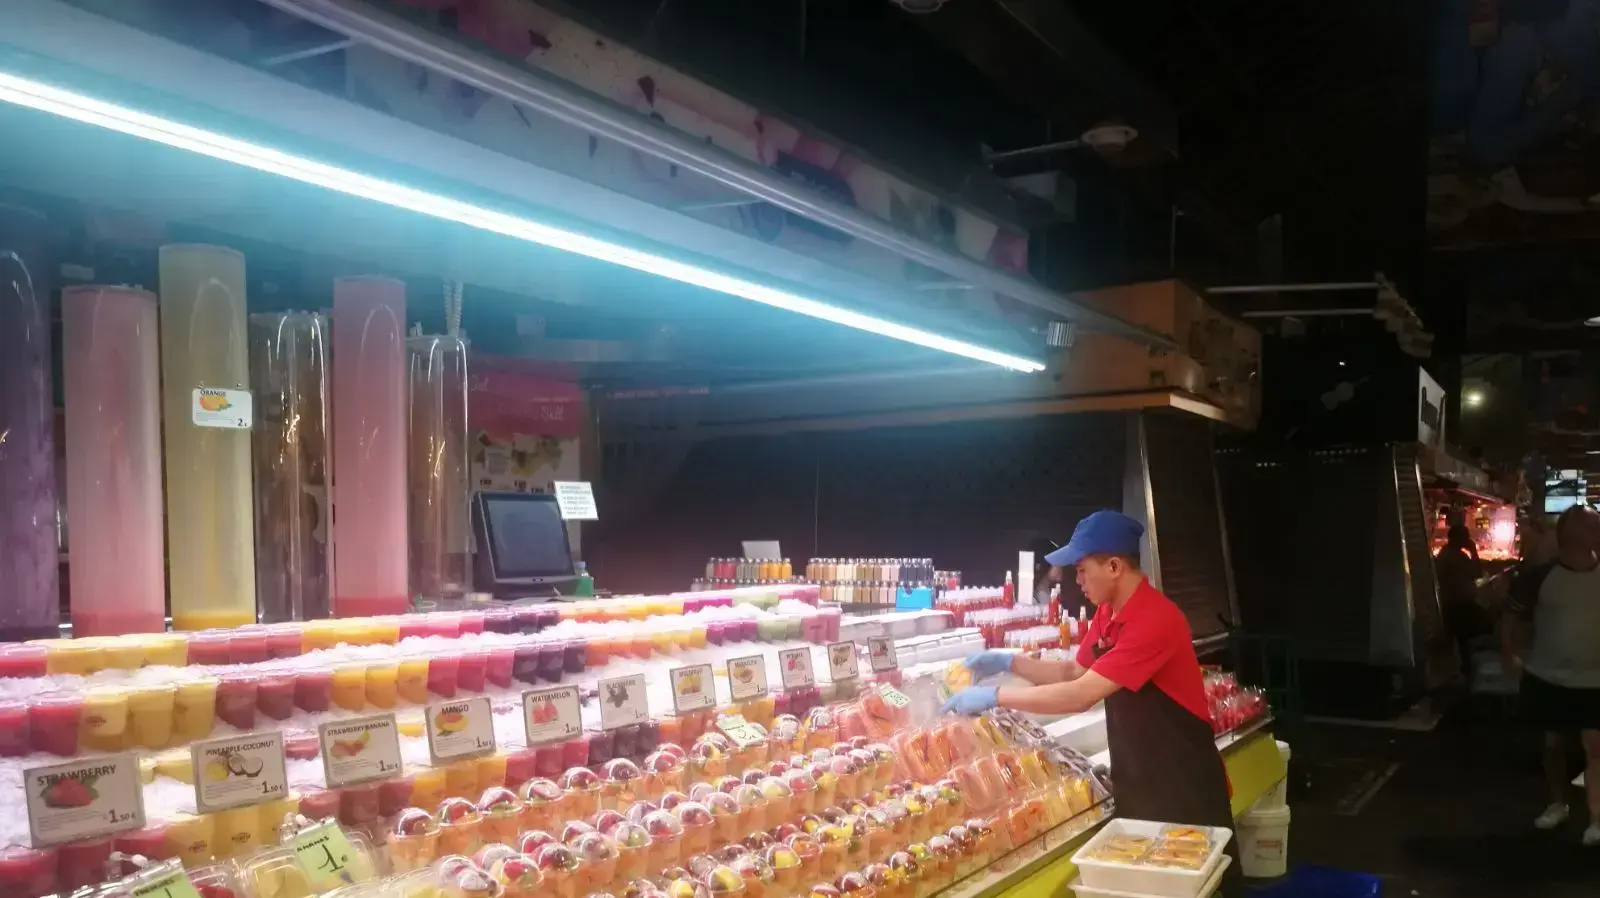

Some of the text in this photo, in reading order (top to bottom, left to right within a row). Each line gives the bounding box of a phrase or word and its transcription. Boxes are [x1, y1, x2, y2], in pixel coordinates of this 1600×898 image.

[200, 389, 227, 397] ORANGE
[531, 690, 571, 704] WATERMELON
[441, 703, 469, 716] MANGO
[327, 721, 390, 737] STRAWBERRY BANANA
[205, 740, 275, 757] PINEAPPLE-COCONUT
[37, 764, 117, 786] STRAWBERRY
